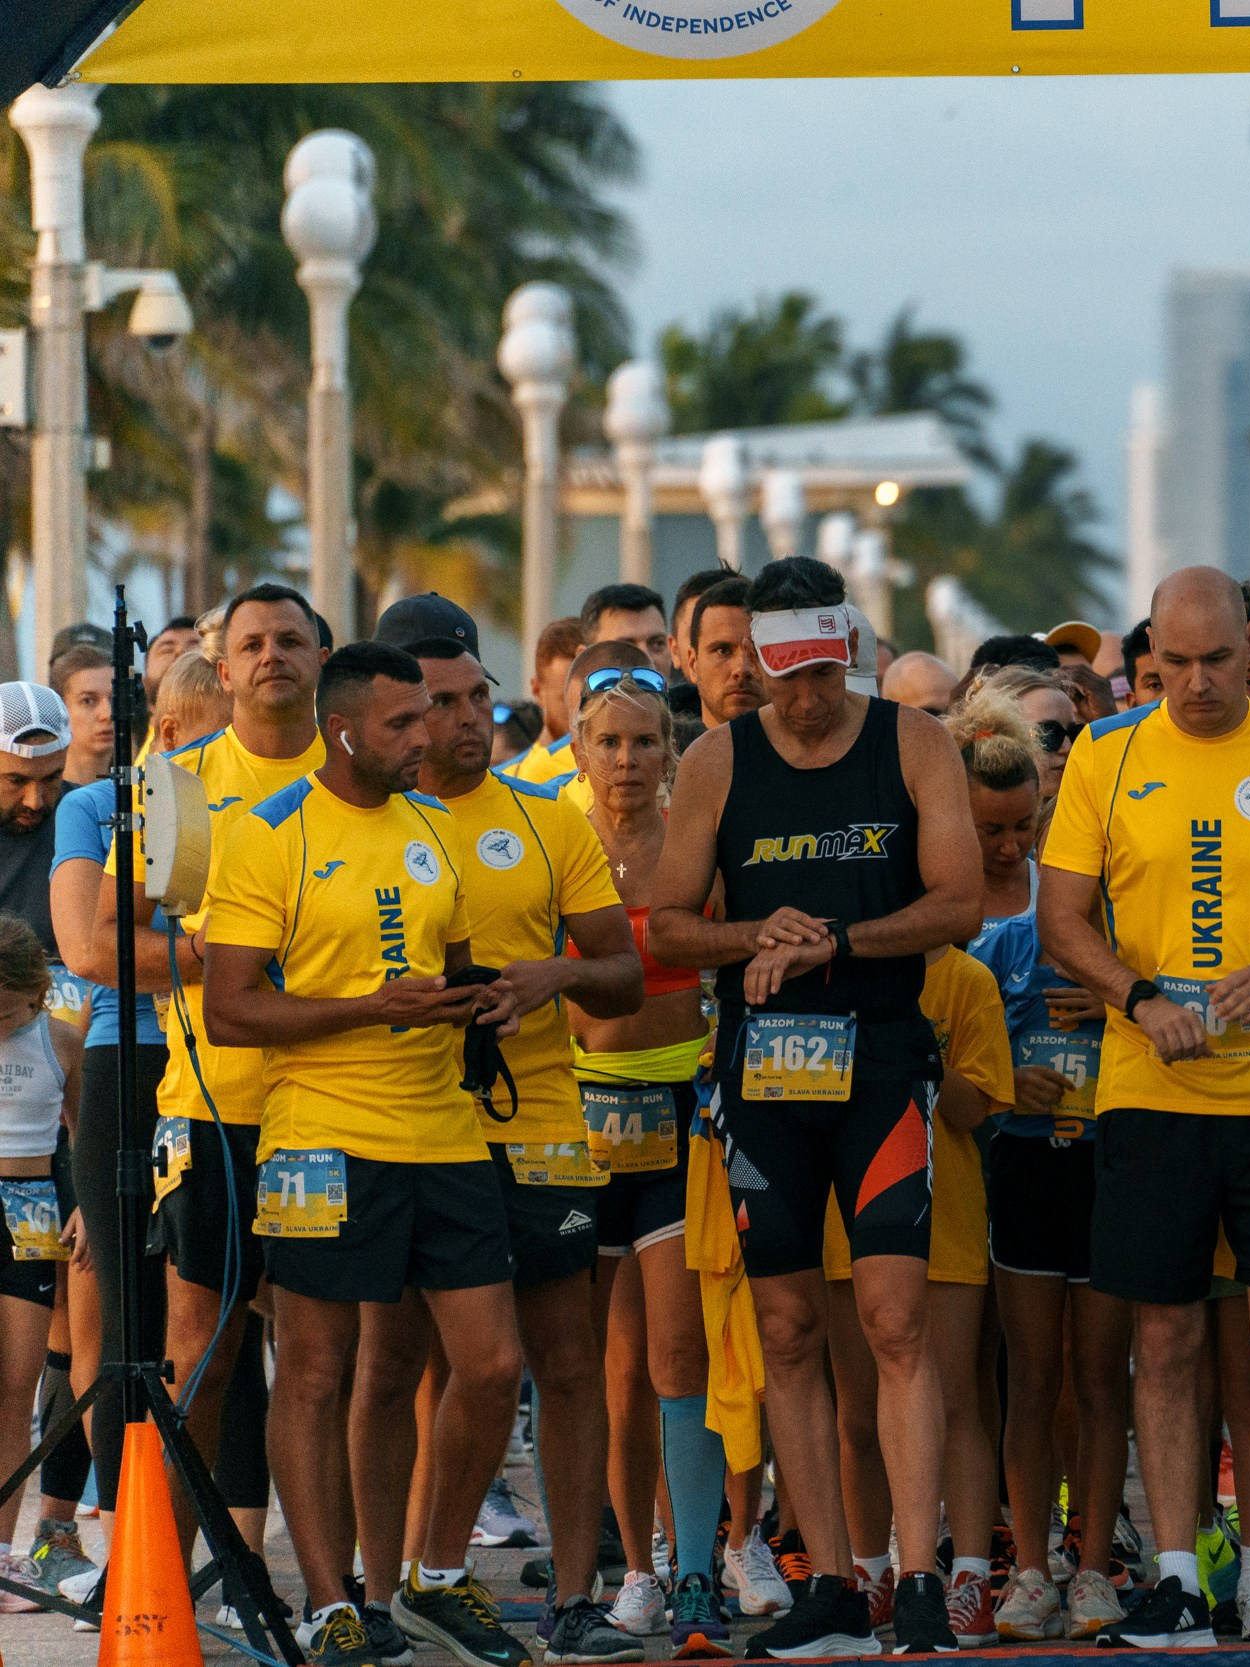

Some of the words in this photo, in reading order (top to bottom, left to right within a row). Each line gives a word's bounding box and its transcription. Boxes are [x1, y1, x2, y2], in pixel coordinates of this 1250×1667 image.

[622, 0, 793, 34] INDEPENDENCE
[1191, 819, 1223, 968] UKRAINE
[1163, 981, 1200, 994] RAZOM
[758, 1018, 795, 1028] RAZOM
[820, 1020, 844, 1030] RUN
[1029, 1036, 1067, 1045] RAZOM
[768, 1035, 828, 1071] 162
[1049, 1053, 1087, 1089] 15
[584, 1091, 619, 1105] RAZOM
[642, 1093, 663, 1104] RUN
[602, 1112, 645, 1146] 44
[309, 1154, 333, 1163] RUN
[277, 1171, 305, 1208] 71
